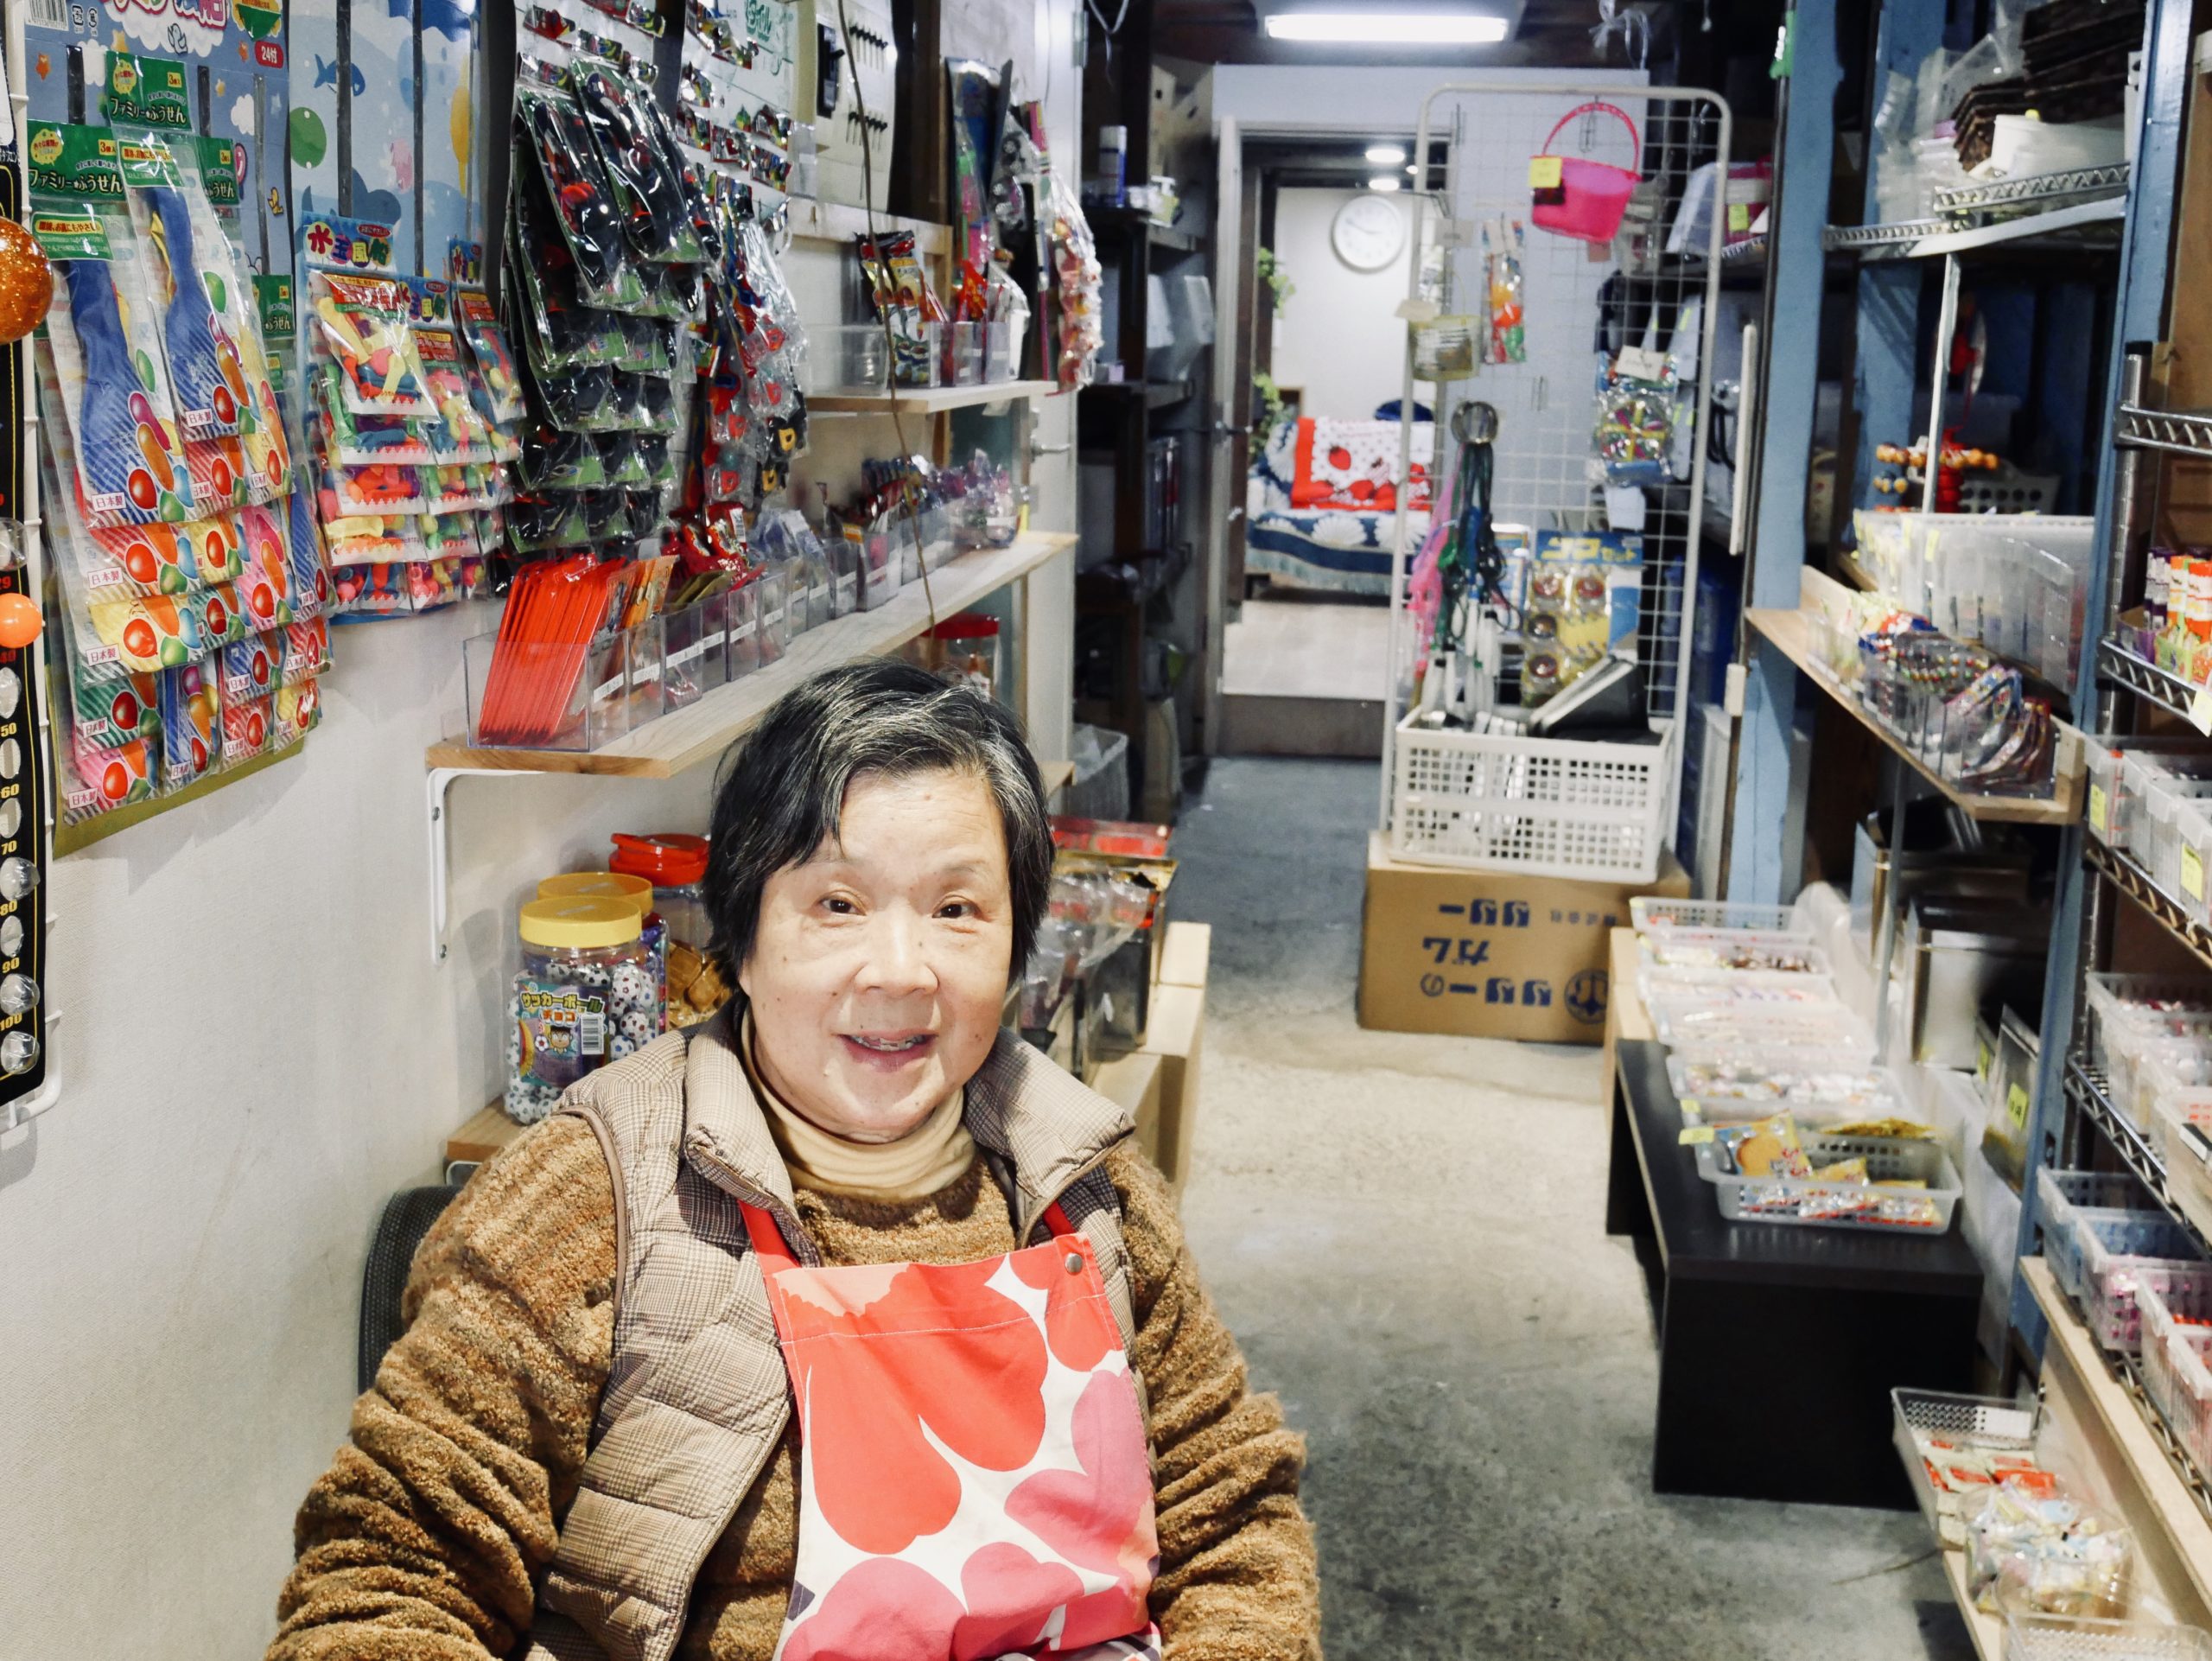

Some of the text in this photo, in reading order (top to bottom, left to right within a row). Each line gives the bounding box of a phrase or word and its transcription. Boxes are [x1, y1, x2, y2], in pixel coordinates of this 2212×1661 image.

[261, 48, 279, 64] 24付
[188, 412, 212, 423] 日本製
[96, 495, 124, 507] 日本製
[92, 570, 119, 585] 日本製
[91, 647, 116, 663] 日本製
[0, 722, 17, 737] 50
[1, 783, 20, 799] 60
[73, 791, 97, 805] 日本製
[2, 840, 17, 855] 70
[0, 899, 17, 916] 80
[3, 957, 20, 973] 90
[0, 1012, 22, 1031] 100
